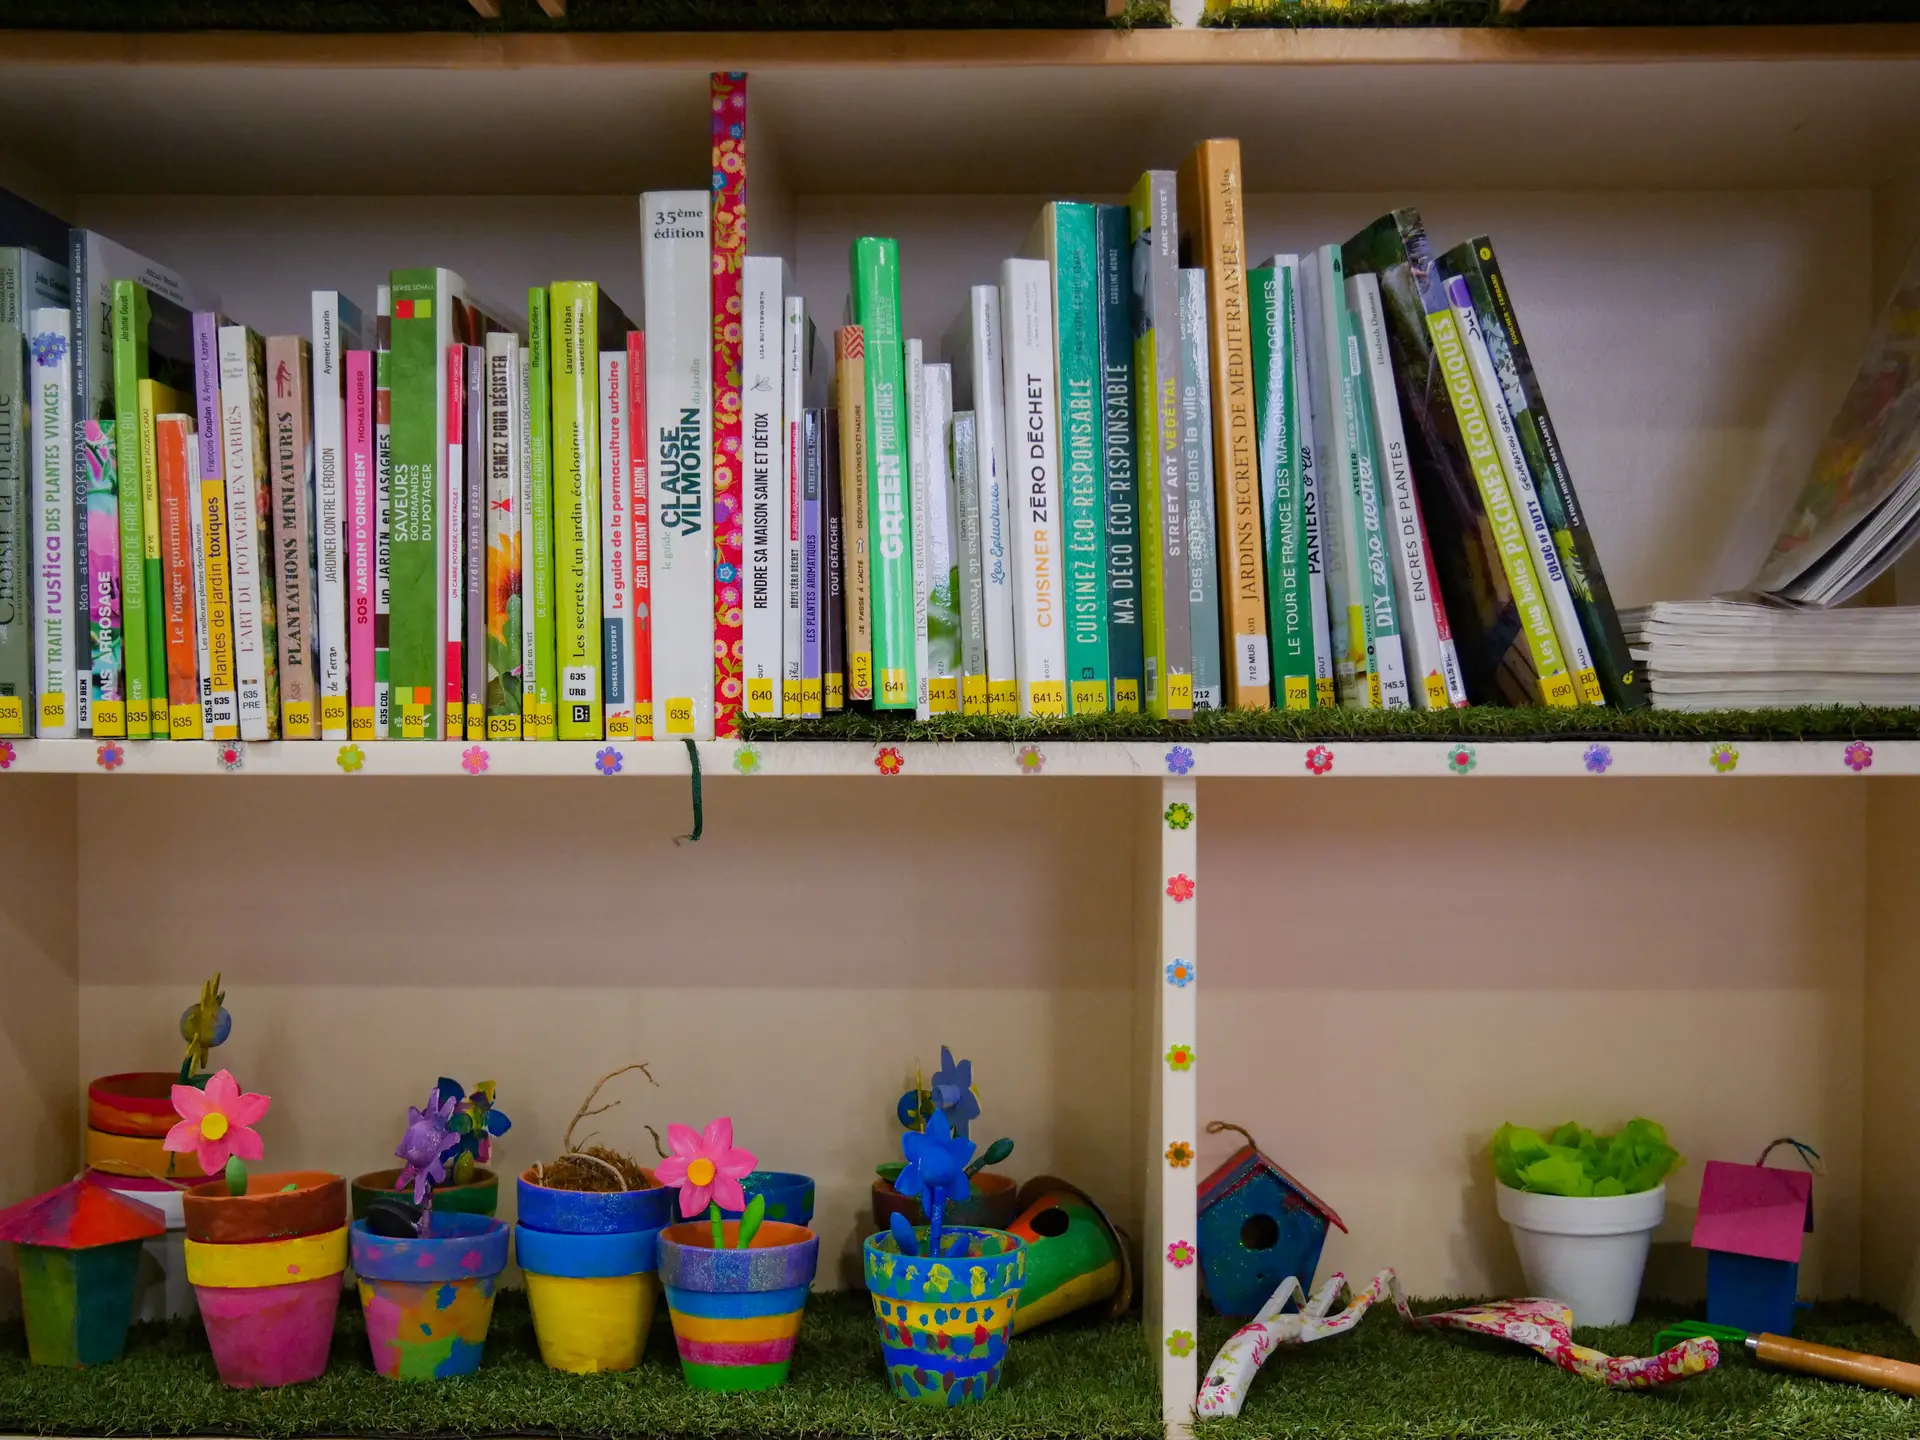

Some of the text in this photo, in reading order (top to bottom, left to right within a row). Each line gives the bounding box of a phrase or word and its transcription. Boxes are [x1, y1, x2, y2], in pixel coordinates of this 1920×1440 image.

[654, 228, 704, 239] édition
[655, 208, 703, 225] 35ème
[1160, 190, 1169, 256] MARC POUYET
[1110, 273, 1119, 304] CAROLINE
[200, 332, 209, 360] Lazarin
[322, 310, 332, 374] Aymeric Lazarin
[531, 306, 540, 368] Maurice Chaudière
[564, 306, 573, 374] Laurent Urban
[202, 362, 211, 393] Aymeric
[357, 370, 365, 405] LOHRER
[489, 355, 508, 406] RÉSISTER
[521, 362, 530, 420] DÉPOLLUANTES
[204, 406, 213, 438] Couplan
[491, 410, 508, 437] POUR
[1220, 244, 1260, 602] JARDINS SECRETS DE MÉDITERRANÉE
[207, 440, 215, 472] François
[278, 412, 297, 529] MINIATURES
[492, 442, 508, 478] SEMEZ
[524, 456, 532, 499] MEILLEURES
[608, 360, 625, 609] Le guide de la permaculture urbaine
[660, 427, 681, 528] CLAUSE
[680, 408, 701, 536] VILMORIN
[1162, 377, 1180, 556] STREET ART VÉGÉTAL
[1264, 280, 1301, 655] LE TOUR DE FRANCE DES MAISONS ÉCOLOGIQUES
[1538, 415, 1581, 526] LA FOLLE HISTOIRE DES PLANTES
[75, 419, 88, 610] Mon atelier KOKEDAMA
[320, 448, 337, 583] JARDINER CONTRE L'ÉROSION
[380, 434, 390, 604] un JARDIN en LASAGNES
[394, 464, 408, 541] SAVEURS
[410, 464, 419, 540] GOURMANDES
[422, 464, 432, 540] DU POTAGER
[752, 413, 768, 609] RENDRE SA MAISON SAINE ET DÉTOX
[876, 455, 904, 559] GREEN
[1069, 378, 1098, 643] CUISINEZ ÉCO-RESPONSABLE
[1106, 364, 1135, 624] MA DÉCO ÉCO-RESPONSABLE
[1182, 386, 1204, 602] Des arbres dans la ville
[1389, 442, 1426, 602] ENCRES DE PLANTES
[1434, 317, 1556, 665] Les plus belles PISCINES ÉCOLOGIQUES
[1526, 500, 1545, 531] DUTY
[42, 383, 63, 694] ETIT TRAITÉ rustica DES PLANTES VIVACES
[226, 405, 254, 652] L'ART DU POTAGER EN CARRÉS
[354, 453, 368, 624] SOS JARDIN D'ORNEMENT
[470, 484, 480, 593] Jardin sans gazon
[569, 421, 587, 657] Les secrets d'un jardin écologique
[829, 517, 839, 596] TOUT DÉTACHER
[167, 497, 186, 644] Le Potager gourmand
[206, 496, 228, 686] Plantes de jardin toxiques
[806, 534, 816, 642] LES PLANTES AROMATIQUES
[1539, 544, 1562, 581] COLOC
[283, 538, 303, 665] PLANTATIONS
[569, 673, 586, 681] 635
[569, 688, 586, 696] URB
[751, 690, 772, 700] 640
[856, 656, 867, 688] 641.2
[884, 681, 904, 692] 641
[919, 678, 928, 705] Rustica
[1033, 692, 1062, 703] 641.5
[1076, 693, 1104, 703] 641.5
[1117, 692, 1136, 701] 643
[1170, 686, 1189, 697] 712
[1289, 689, 1307, 699] 728
[1428, 687, 1445, 697] 751
[1551, 684, 1571, 698] 690
[405, 715, 422, 725] 635
[670, 709, 690, 720] 635
